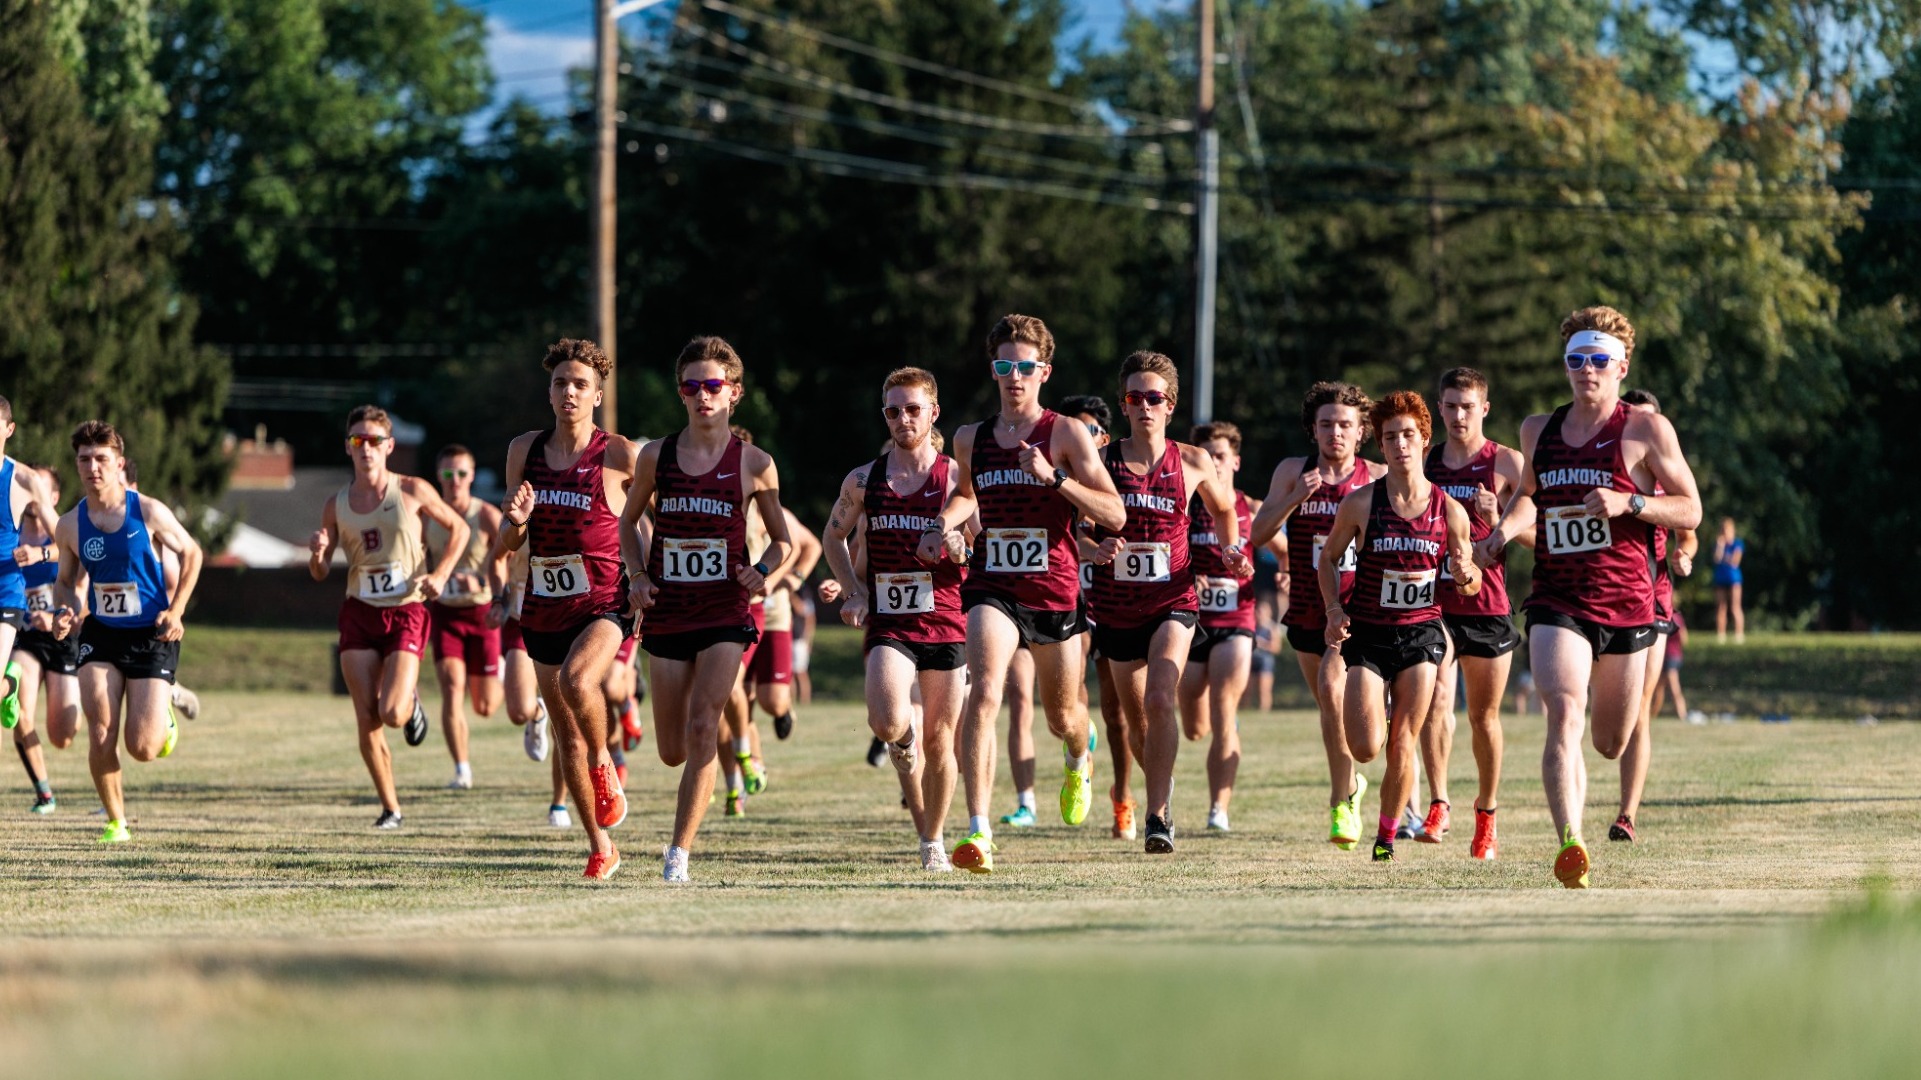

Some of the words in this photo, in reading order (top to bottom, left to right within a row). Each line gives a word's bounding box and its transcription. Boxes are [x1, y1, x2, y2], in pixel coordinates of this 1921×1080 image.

[1539, 468, 1614, 490] ROANOKE
[661, 497, 733, 517] ROANOKE
[1300, 501, 1338, 516] ROAN
[362, 528, 381, 552] B
[1551, 518, 1606, 549] 108
[991, 541, 1043, 567] 102
[1373, 537, 1440, 556] ROANOKE
[669, 551, 722, 577] 103
[1126, 554, 1156, 577] 91
[368, 574, 394, 594] 12
[543, 568, 575, 592] 90
[102, 593, 127, 613] 27
[888, 585, 919, 610] 97
[1201, 588, 1227, 607] 96
[1386, 581, 1432, 605] 104
